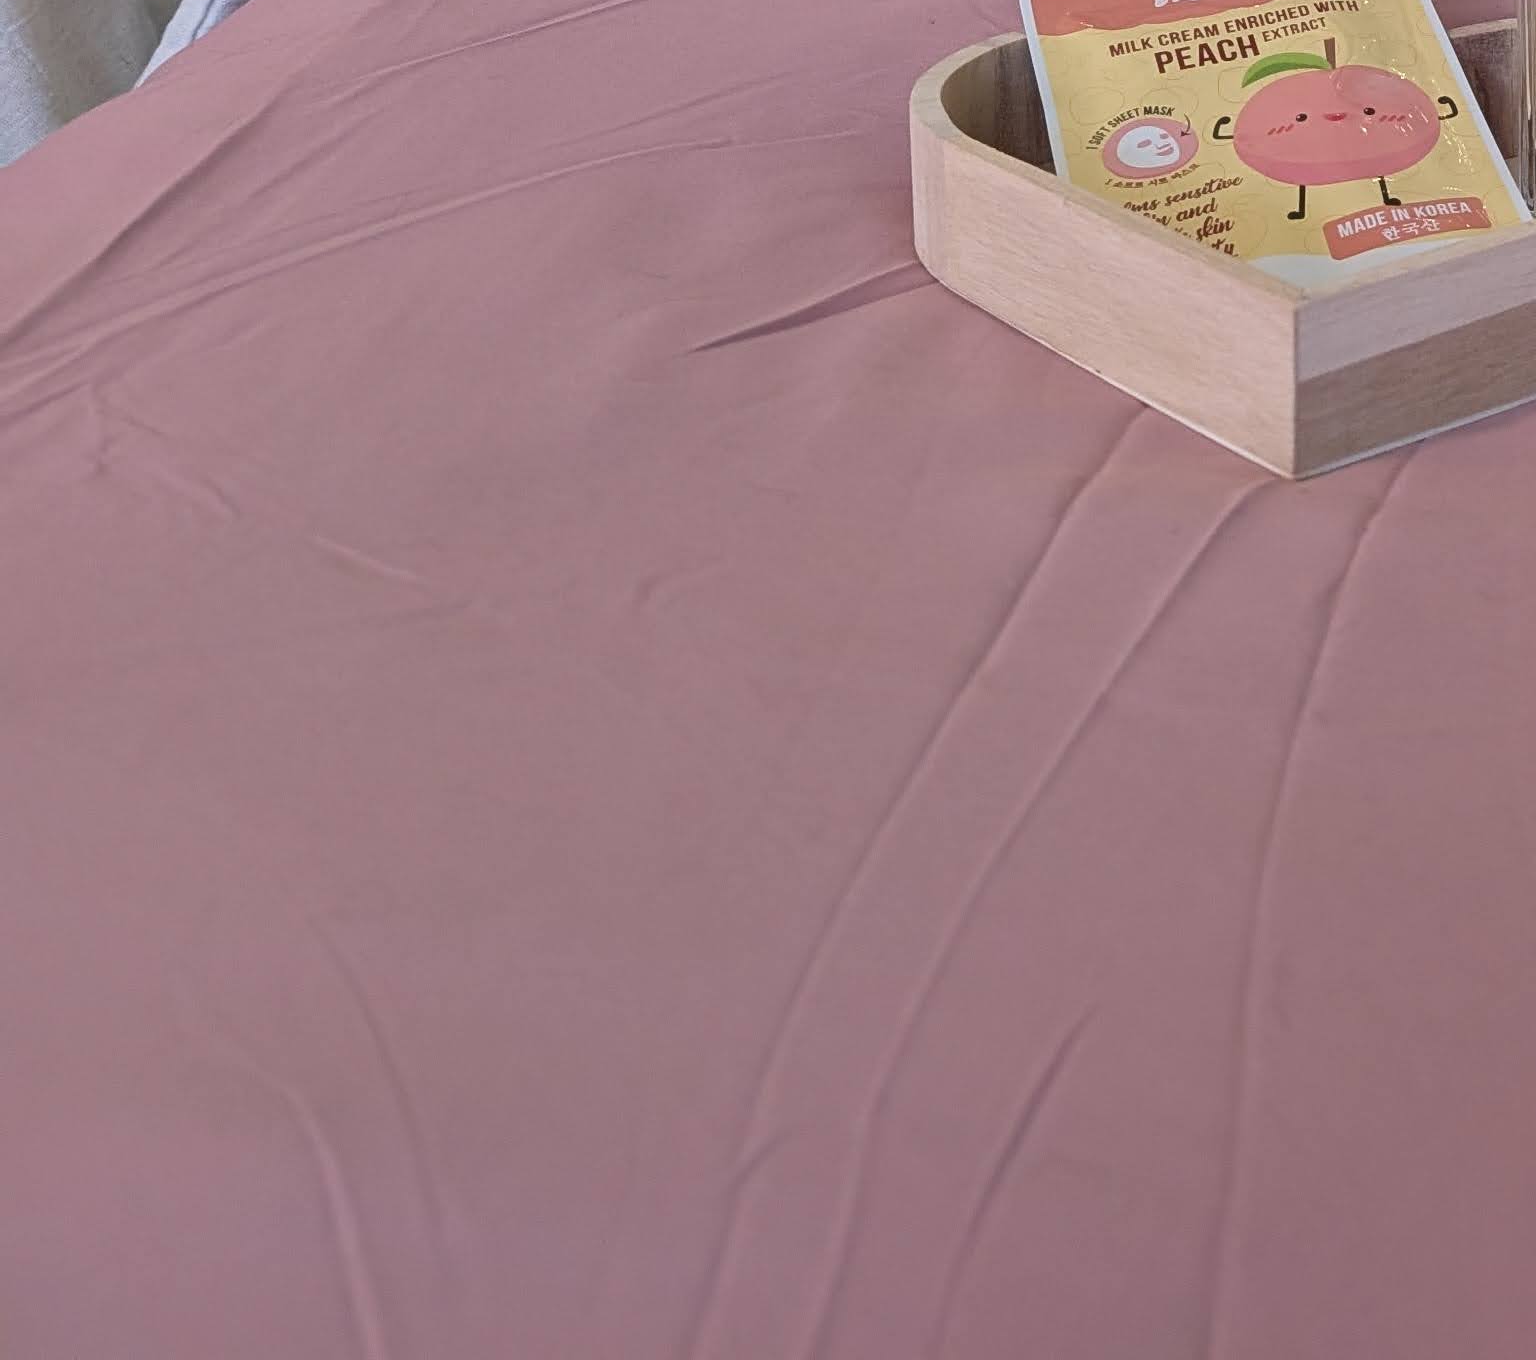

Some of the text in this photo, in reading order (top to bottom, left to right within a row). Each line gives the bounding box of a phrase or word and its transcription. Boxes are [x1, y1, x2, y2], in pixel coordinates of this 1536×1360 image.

[1108, 0, 1360, 58] MILK CREAM ENRICHED WITH
[1154, 16, 1327, 74] PEACH EXTRACT
[1088, 126, 1111, 146] SOFT
[1108, 108, 1140, 128] SHEET
[1143, 105, 1176, 116] MASK
[1164, 175, 1244, 206] sensitive
[1175, 197, 1218, 222] and
[1336, 201, 1472, 238] MADE IN KOREA
[1196, 215, 1235, 243] skin
